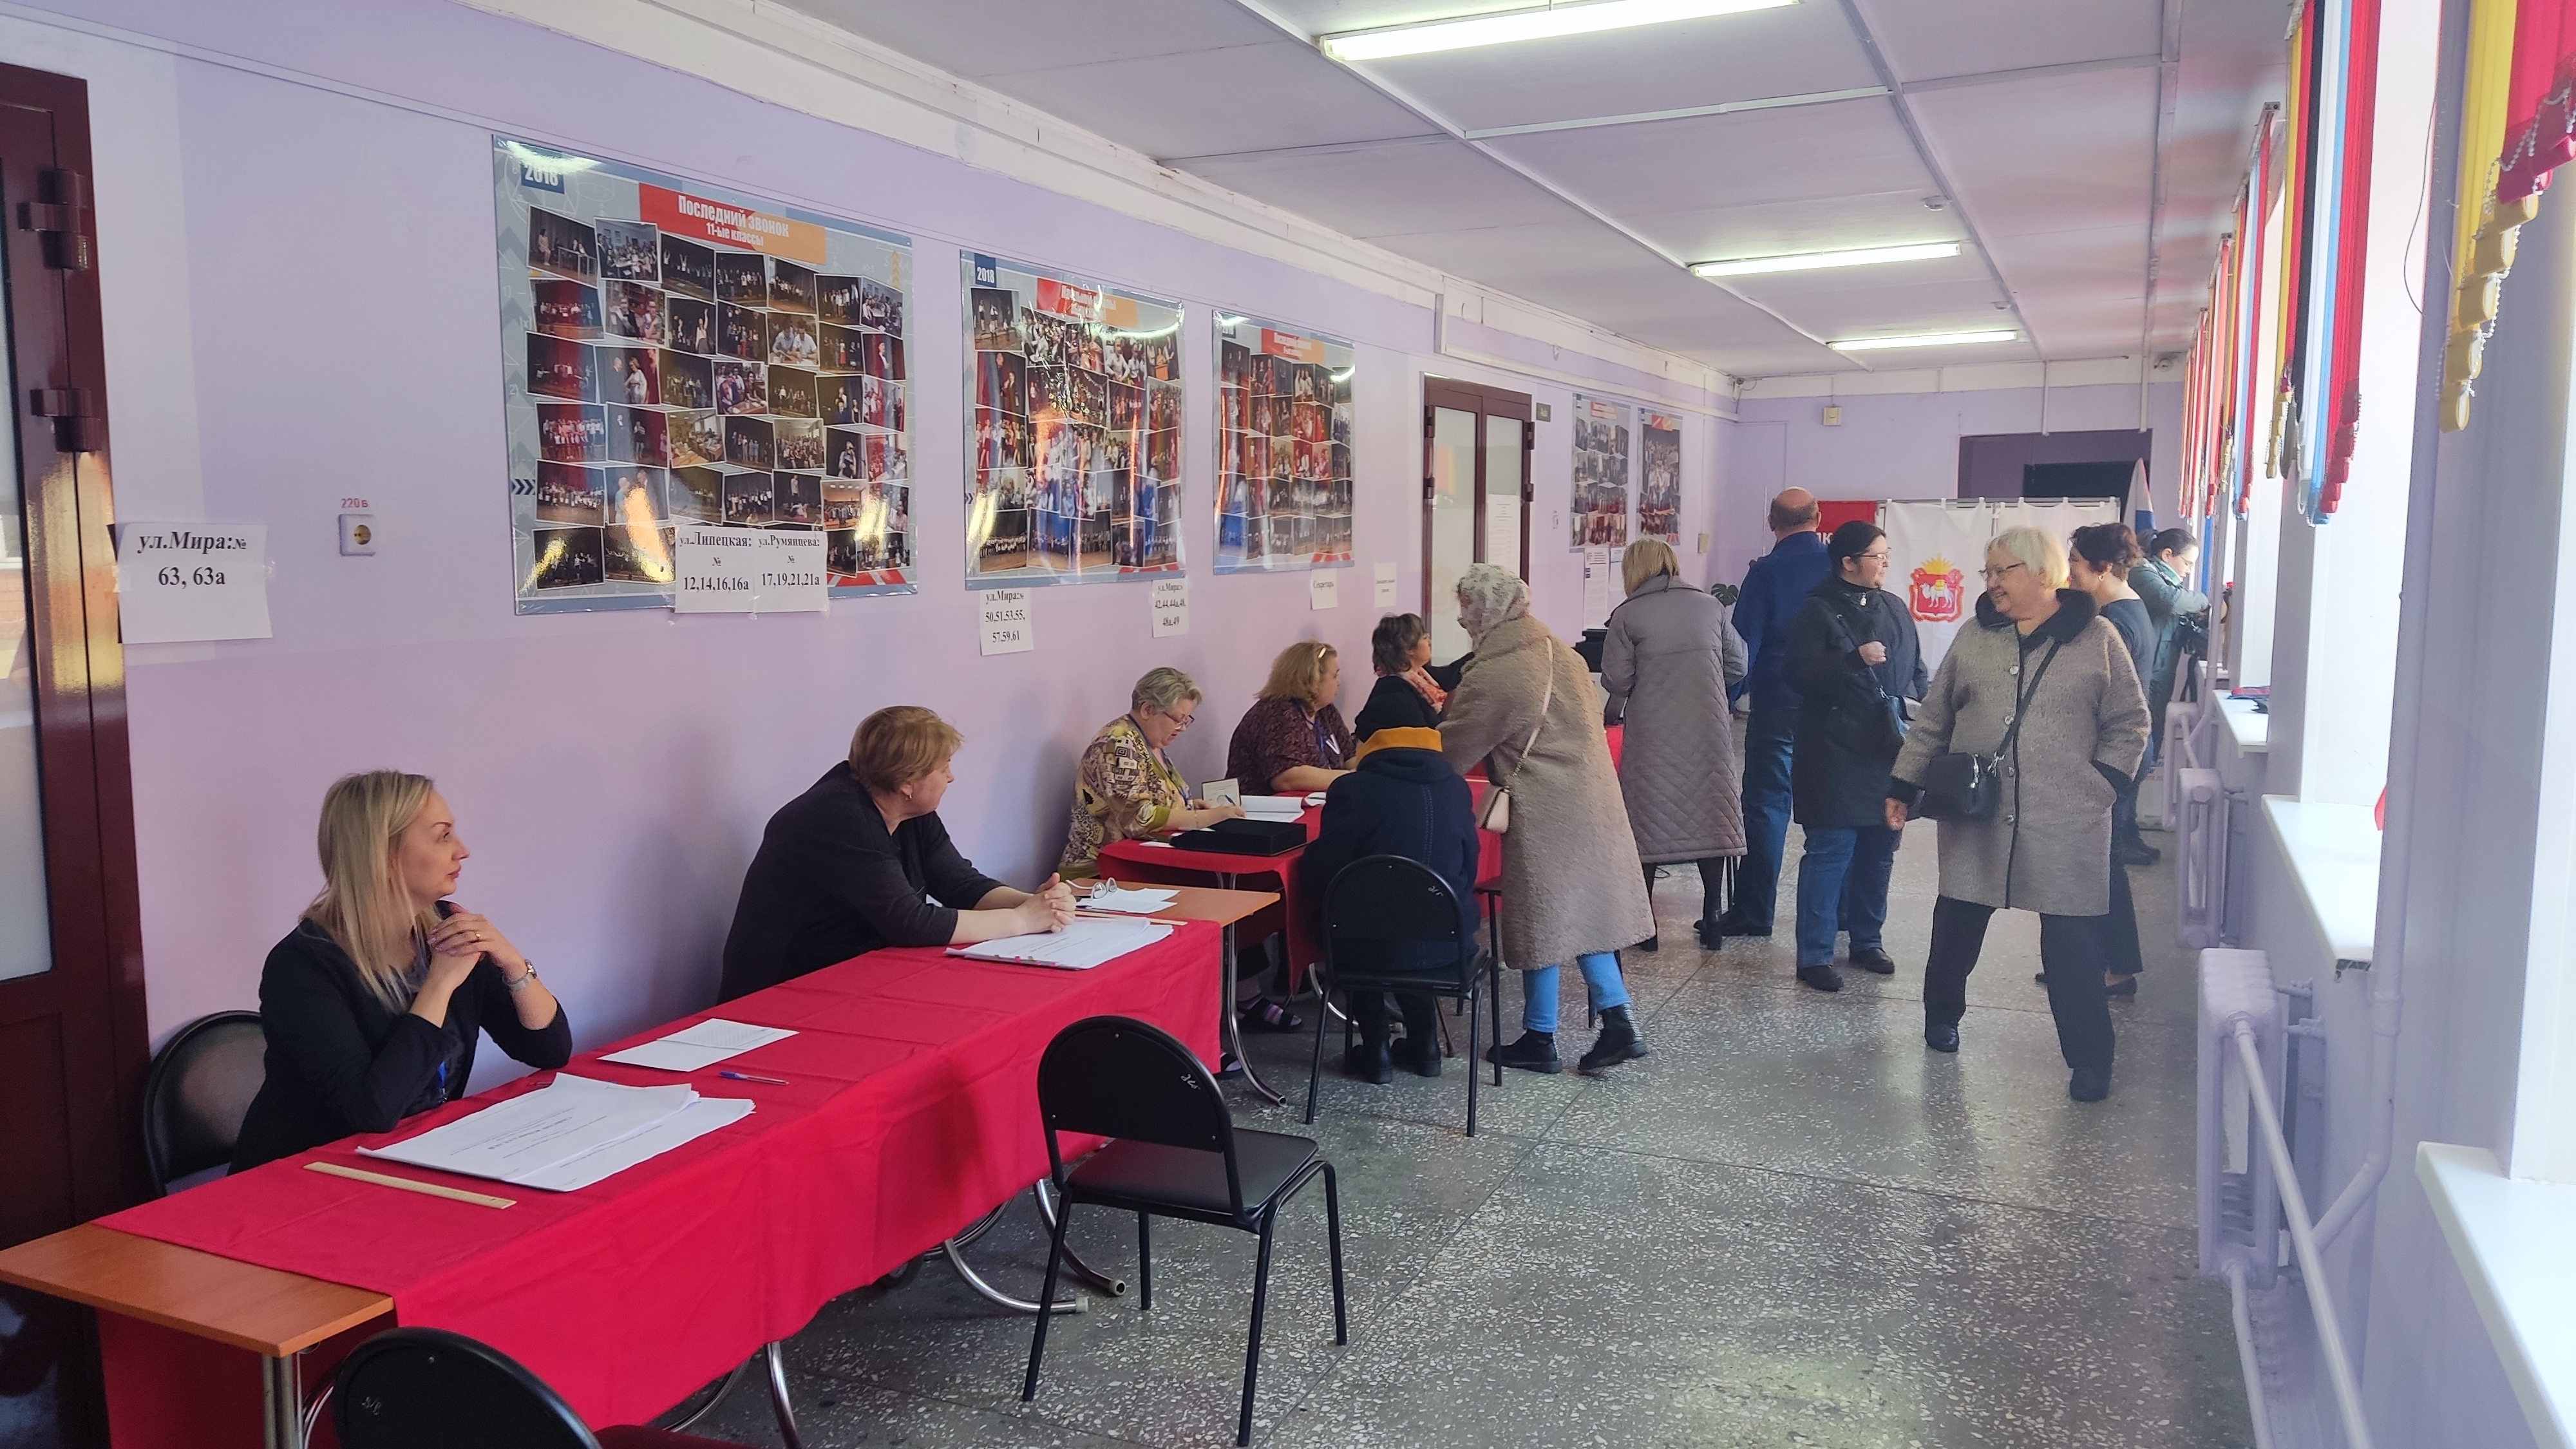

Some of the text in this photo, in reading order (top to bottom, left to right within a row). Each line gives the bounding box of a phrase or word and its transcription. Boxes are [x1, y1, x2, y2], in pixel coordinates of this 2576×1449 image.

[678, 194, 790, 238] Последний звонок
[706, 222, 764, 246] 11-ые классы
[976, 266, 995, 284] 2018
[158, 566, 225, 589] 63, 63а
